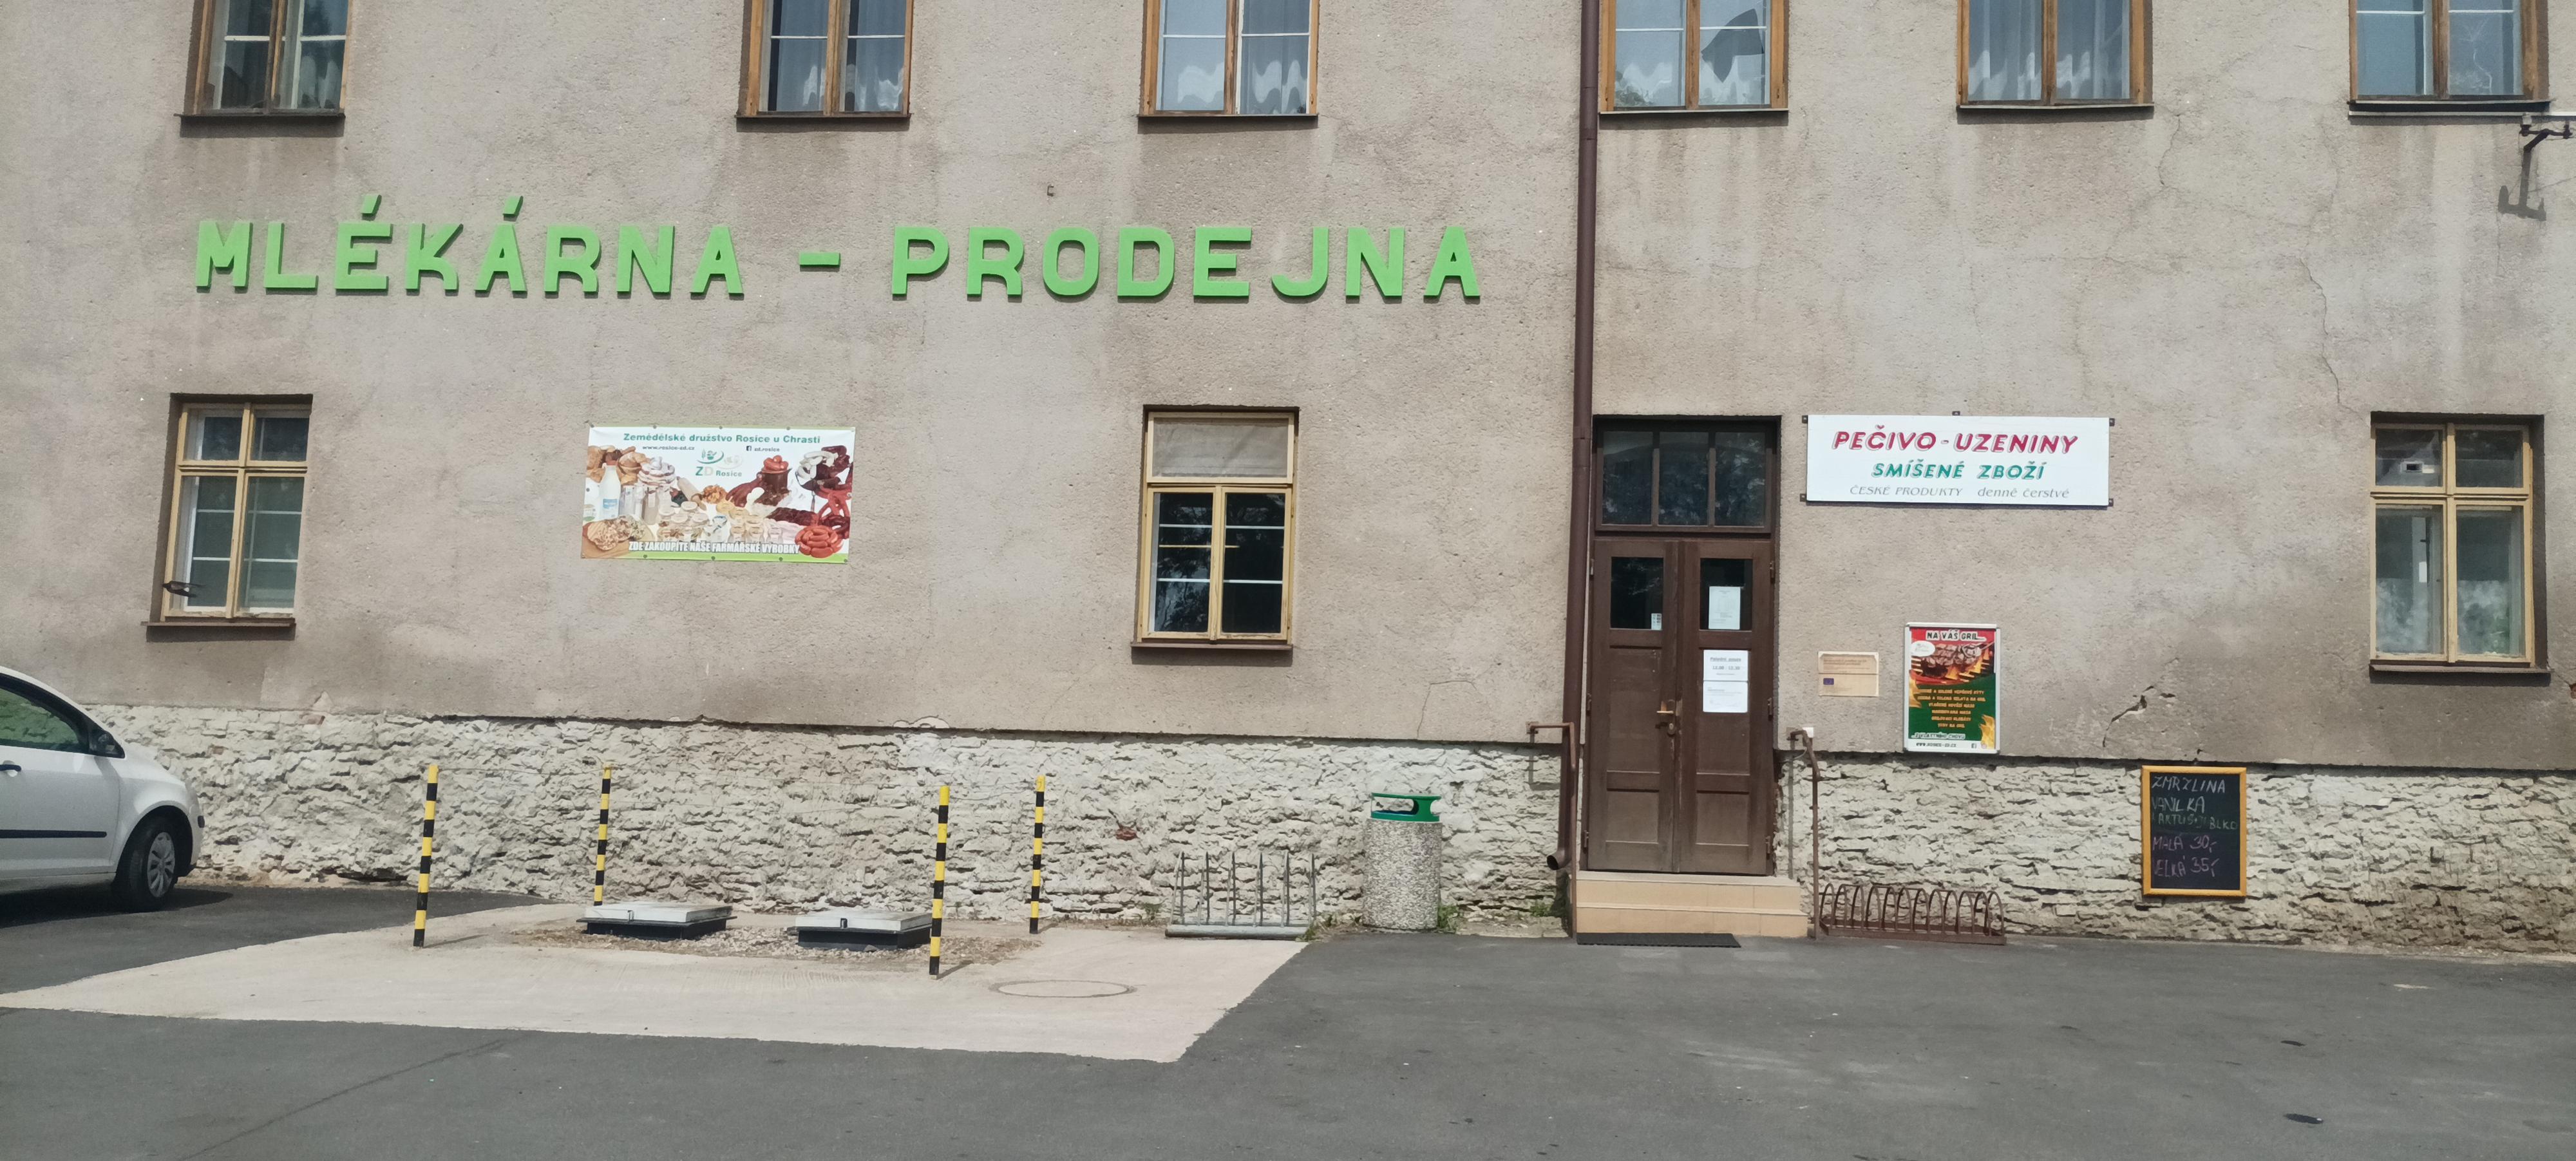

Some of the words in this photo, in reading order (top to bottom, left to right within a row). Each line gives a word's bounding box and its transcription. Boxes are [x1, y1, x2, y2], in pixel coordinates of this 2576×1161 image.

[195, 194, 744, 297] MLÉKÁRNA
[891, 226, 1481, 300] PRODEJNA
[689, 434, 732, 443] družstvo
[735, 434, 770, 443] Rosice
[782, 435, 820, 444] Chrasti
[1832, 424, 1937, 450] PEČIVO
[1953, 432, 2079, 455] UZENINY
[1871, 459, 1965, 479] SMÍŠENÉ
[1976, 461, 2047, 480] ZBOŽÍ
[1850, 484, 1891, 496] ČESKÉ
[1895, 487, 1964, 497] PRODUKTY
[2022, 488, 2070, 498] čerstvé
[629, 541, 643, 551] ZDE
[644, 541, 688, 552] ZAKOUPÍTE
[690, 541, 711, 552] NAŠE
[712, 541, 761, 553] FARMÁŘSKÉ
[761, 542, 800, 554] VÝROBKY
[1942, 629, 1958, 640] VÁŠ
[2151, 775, 2226, 794] ZMRZLINA
